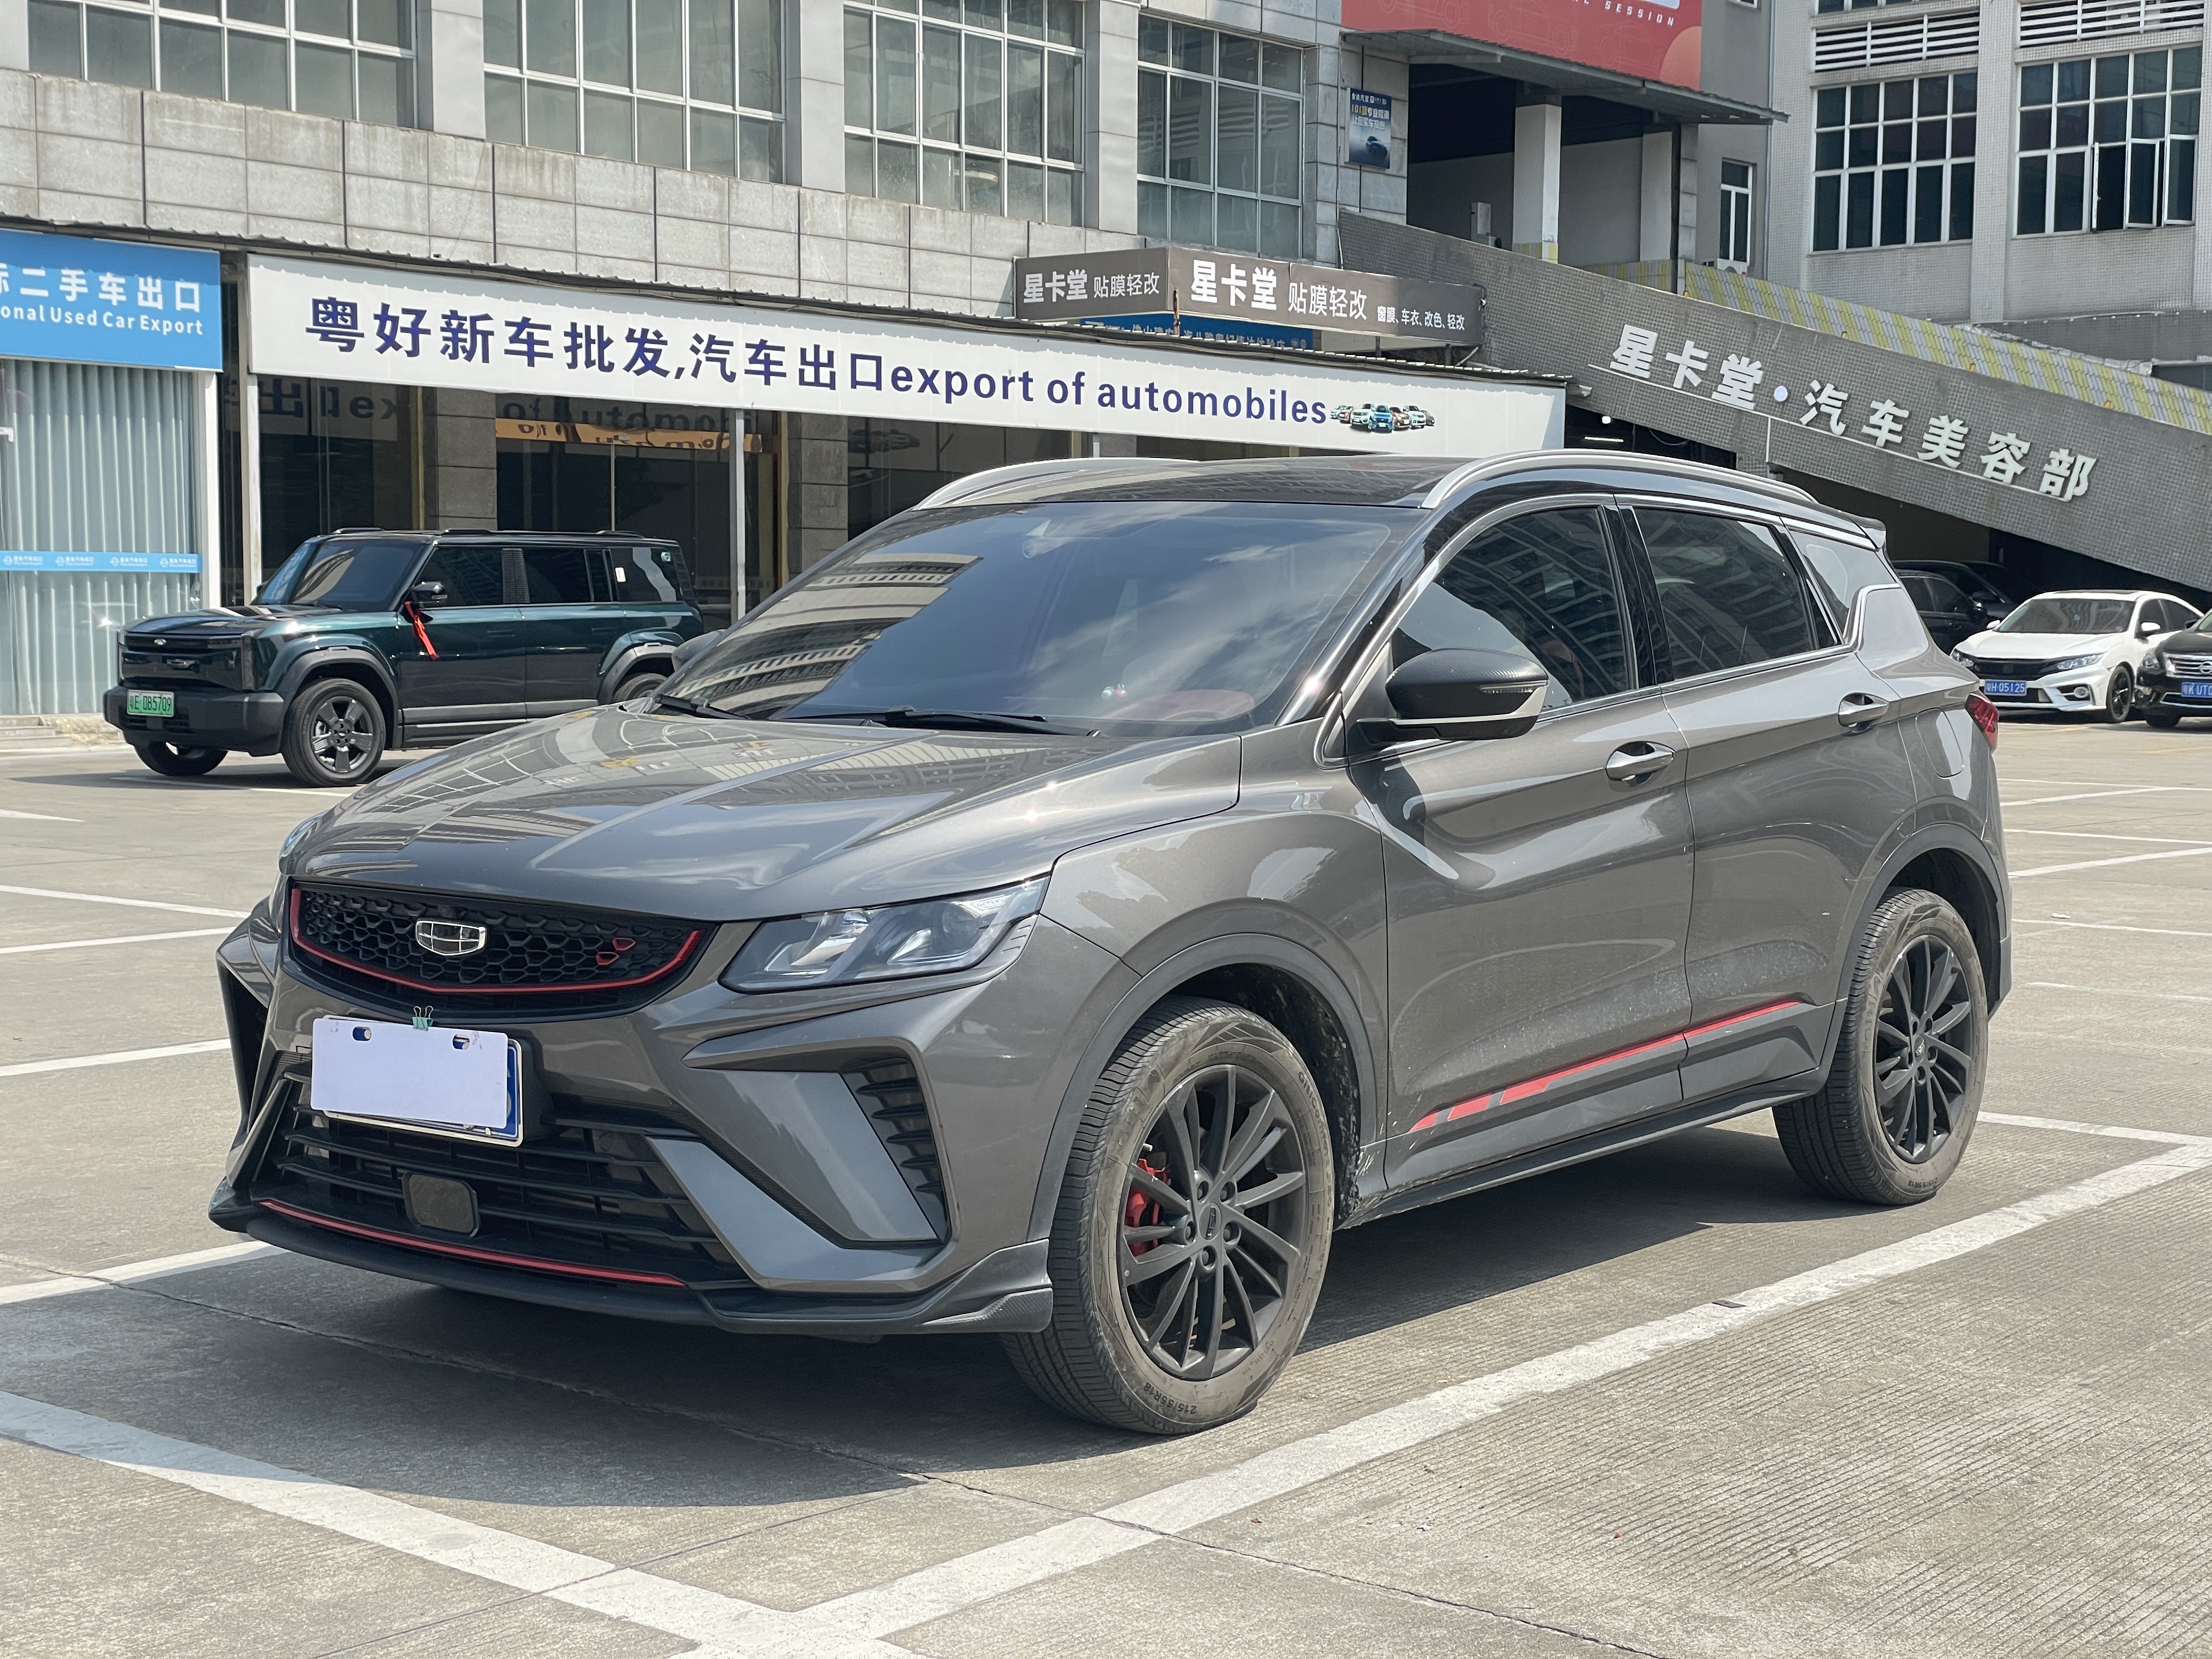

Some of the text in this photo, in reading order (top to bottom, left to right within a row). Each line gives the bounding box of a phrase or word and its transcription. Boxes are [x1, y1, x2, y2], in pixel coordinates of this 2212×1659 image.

[1604, 0, 1674, 26] SESSION
[1024, 269, 1160, 303] 星卡堂 贴膜轻改
[1190, 259, 1465, 330] 星卡堂 贴膜轻改 窗膜、车衣、改色、轻改
[50, 307, 97, 326] Used
[103, 312, 134, 329] Car
[140, 315, 203, 336] Export
[1048, 371, 1085, 404] of
[1098, 382, 1327, 425] automobiles
[977, 899, 1000, 907] GEELY
[1143, 1381, 1197, 1415] 215/55R18
